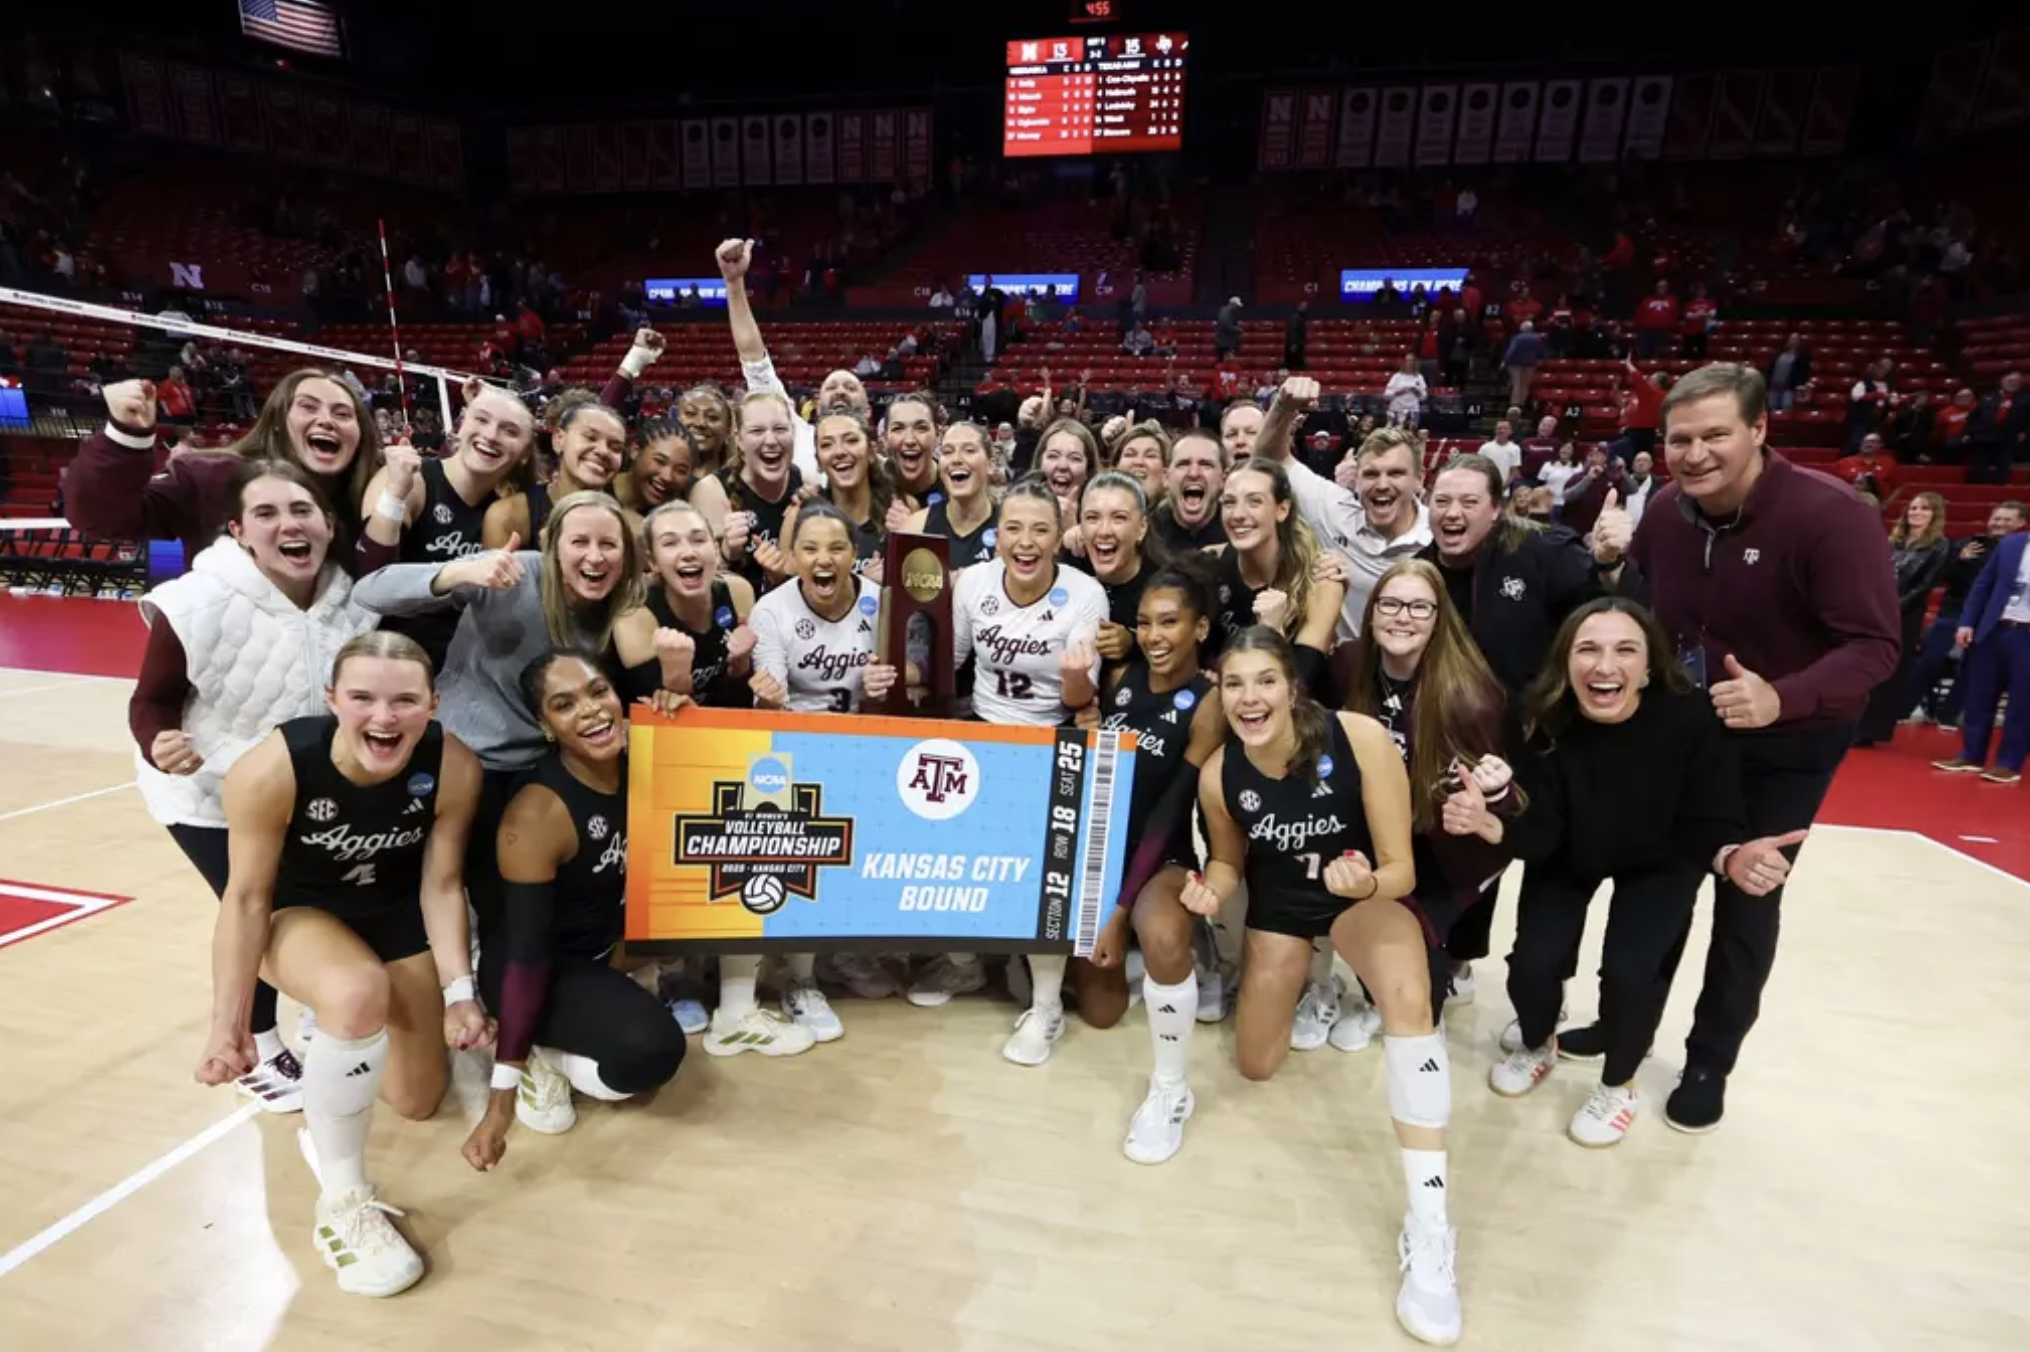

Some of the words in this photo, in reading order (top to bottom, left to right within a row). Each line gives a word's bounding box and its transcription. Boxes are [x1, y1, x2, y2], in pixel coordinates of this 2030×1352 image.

[1125, 38, 1140, 54] 15
[169, 262, 204, 289] N
[1467, 405, 1481, 415] A1
[1565, 407, 1581, 417] A2
[976, 624, 1052, 665] Aggies
[797, 644, 873, 681] Aggie
[994, 668, 1034, 699] 12
[827, 686, 852, 713] 3
[1058, 741, 1082, 772] 25
[753, 773, 787, 786] NCAA
[1059, 771, 1076, 797] SEAT
[306, 798, 340, 822] SEC
[1051, 805, 1077, 834] 18
[724, 820, 806, 835] VOLLEYBALL
[1248, 813, 1347, 851] Aggies
[300, 823, 423, 861] Aggies
[686, 835, 842, 857] CHAMPIONSHIP
[1053, 834, 1069, 860] ROW
[752, 863, 785, 873] KANSAS
[786, 863, 807, 873] CITY
[861, 853, 968, 880] KANSAS
[970, 856, 1032, 883] CITY
[1293, 852, 1321, 880] 7
[1045, 871, 1070, 898] 12
[898, 885, 989, 913] BOUND
[1045, 898, 1063, 941] SECTION
